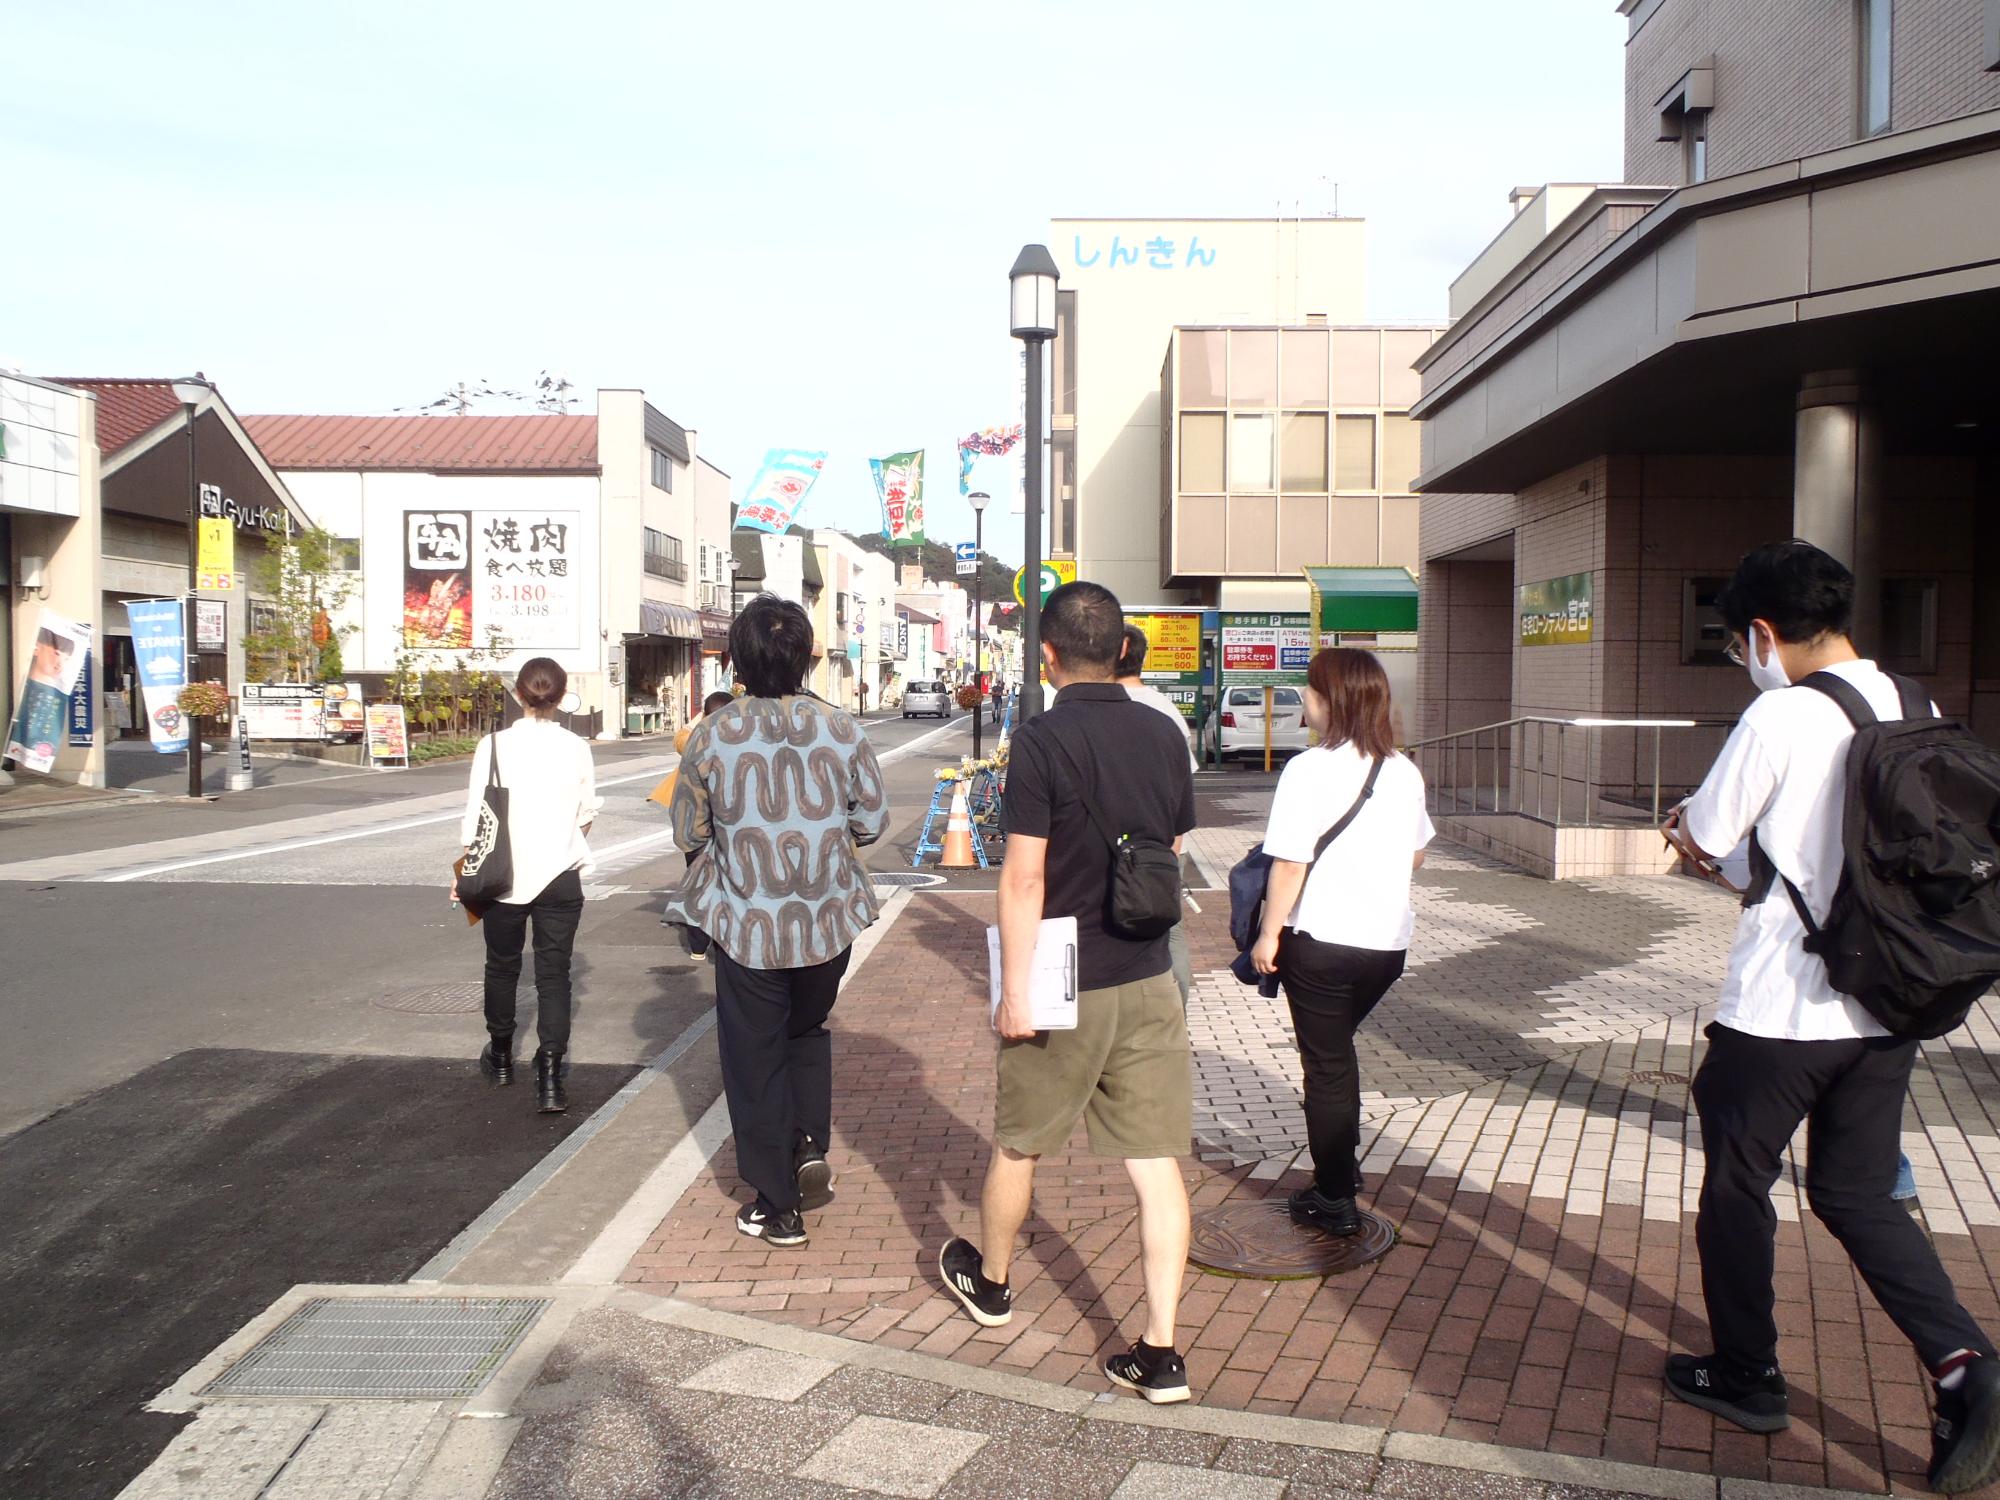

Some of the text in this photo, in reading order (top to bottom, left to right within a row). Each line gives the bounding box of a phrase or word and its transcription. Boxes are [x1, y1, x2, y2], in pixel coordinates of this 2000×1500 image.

[1075, 235, 1217, 269] しんきん
[483, 516, 567, 554] 焼肉
[899, 619, 908, 653] SONY
[1271, 616, 1280, 625] P
[74, 664, 87, 729] 日本大震災
